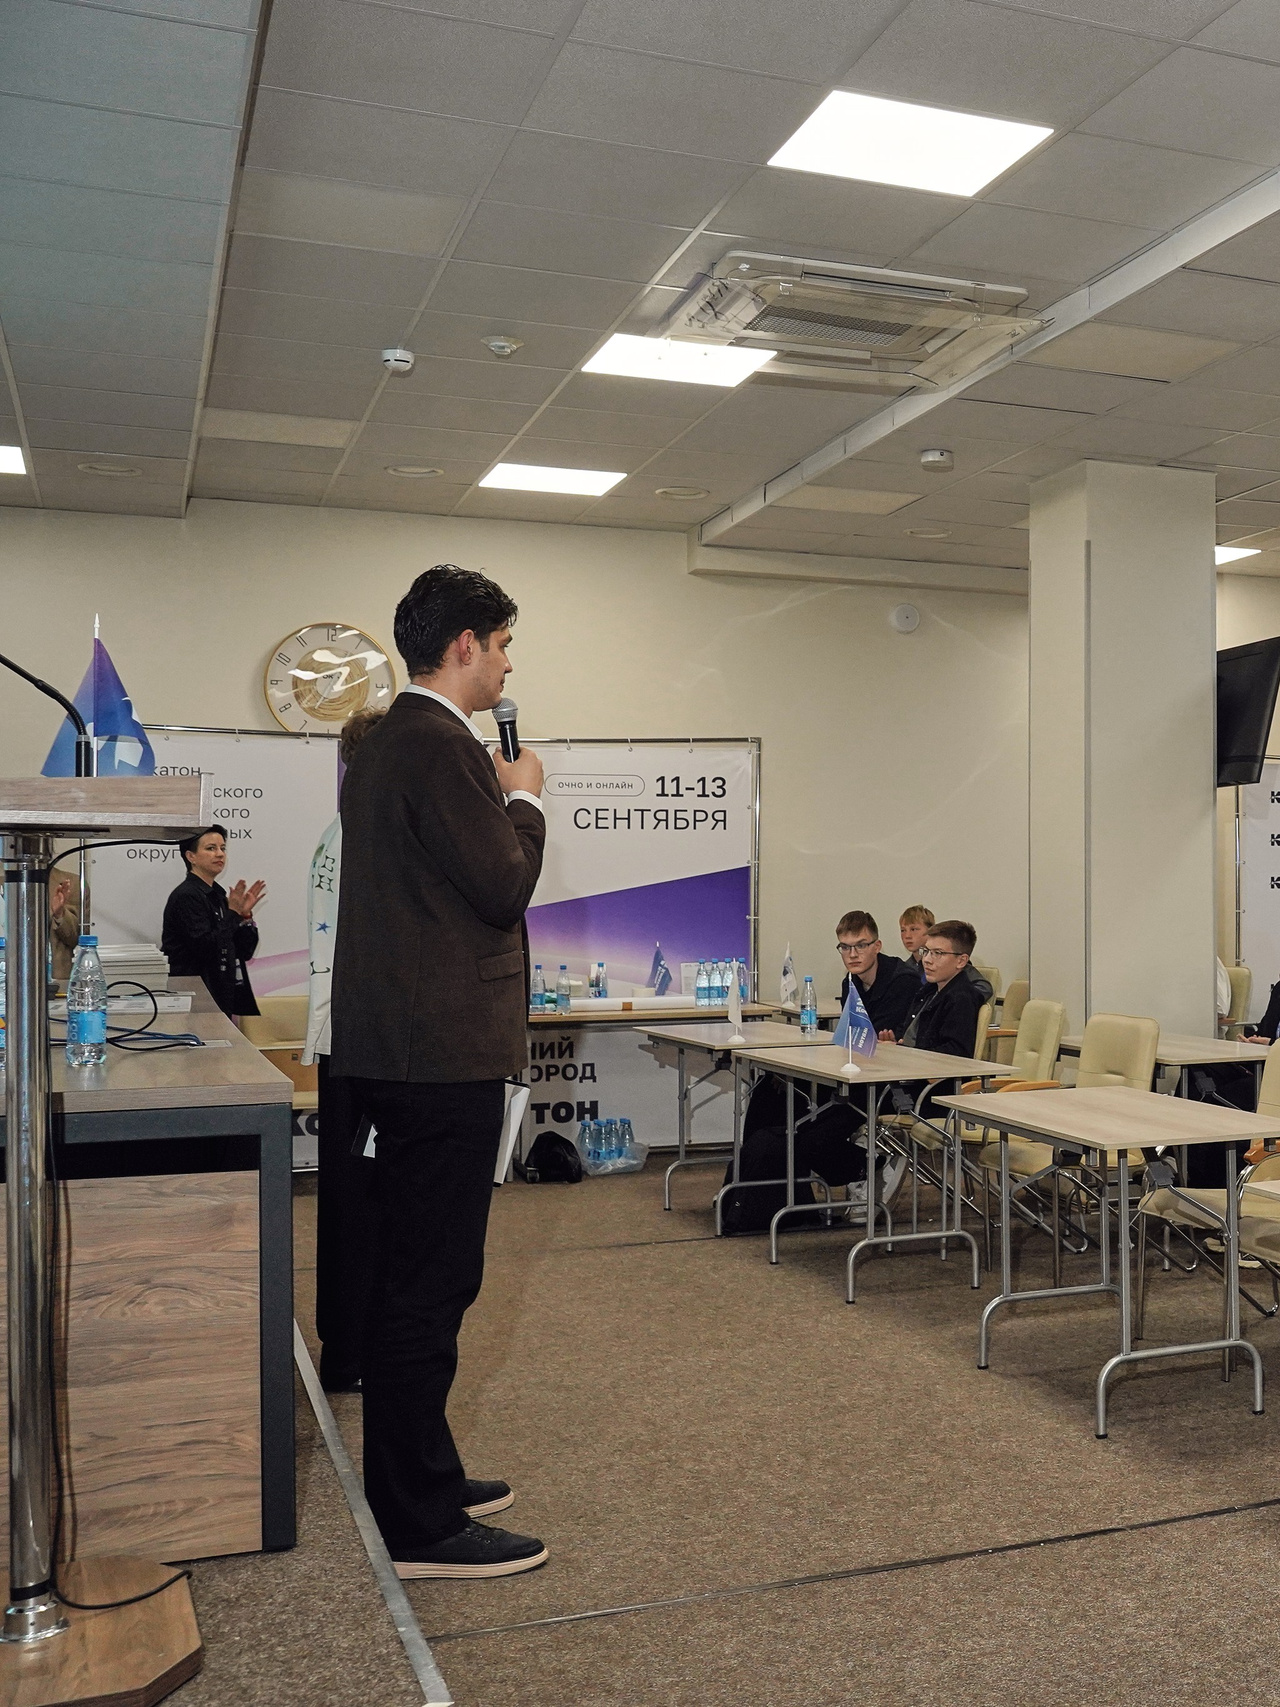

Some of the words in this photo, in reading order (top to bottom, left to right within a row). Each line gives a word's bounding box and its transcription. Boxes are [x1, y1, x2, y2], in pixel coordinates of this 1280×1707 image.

[595, 781, 634, 789] ОНЛАЙН
[655, 775, 727, 799] 11-13
[573, 808, 727, 831] СЕНТЯБРЯ
